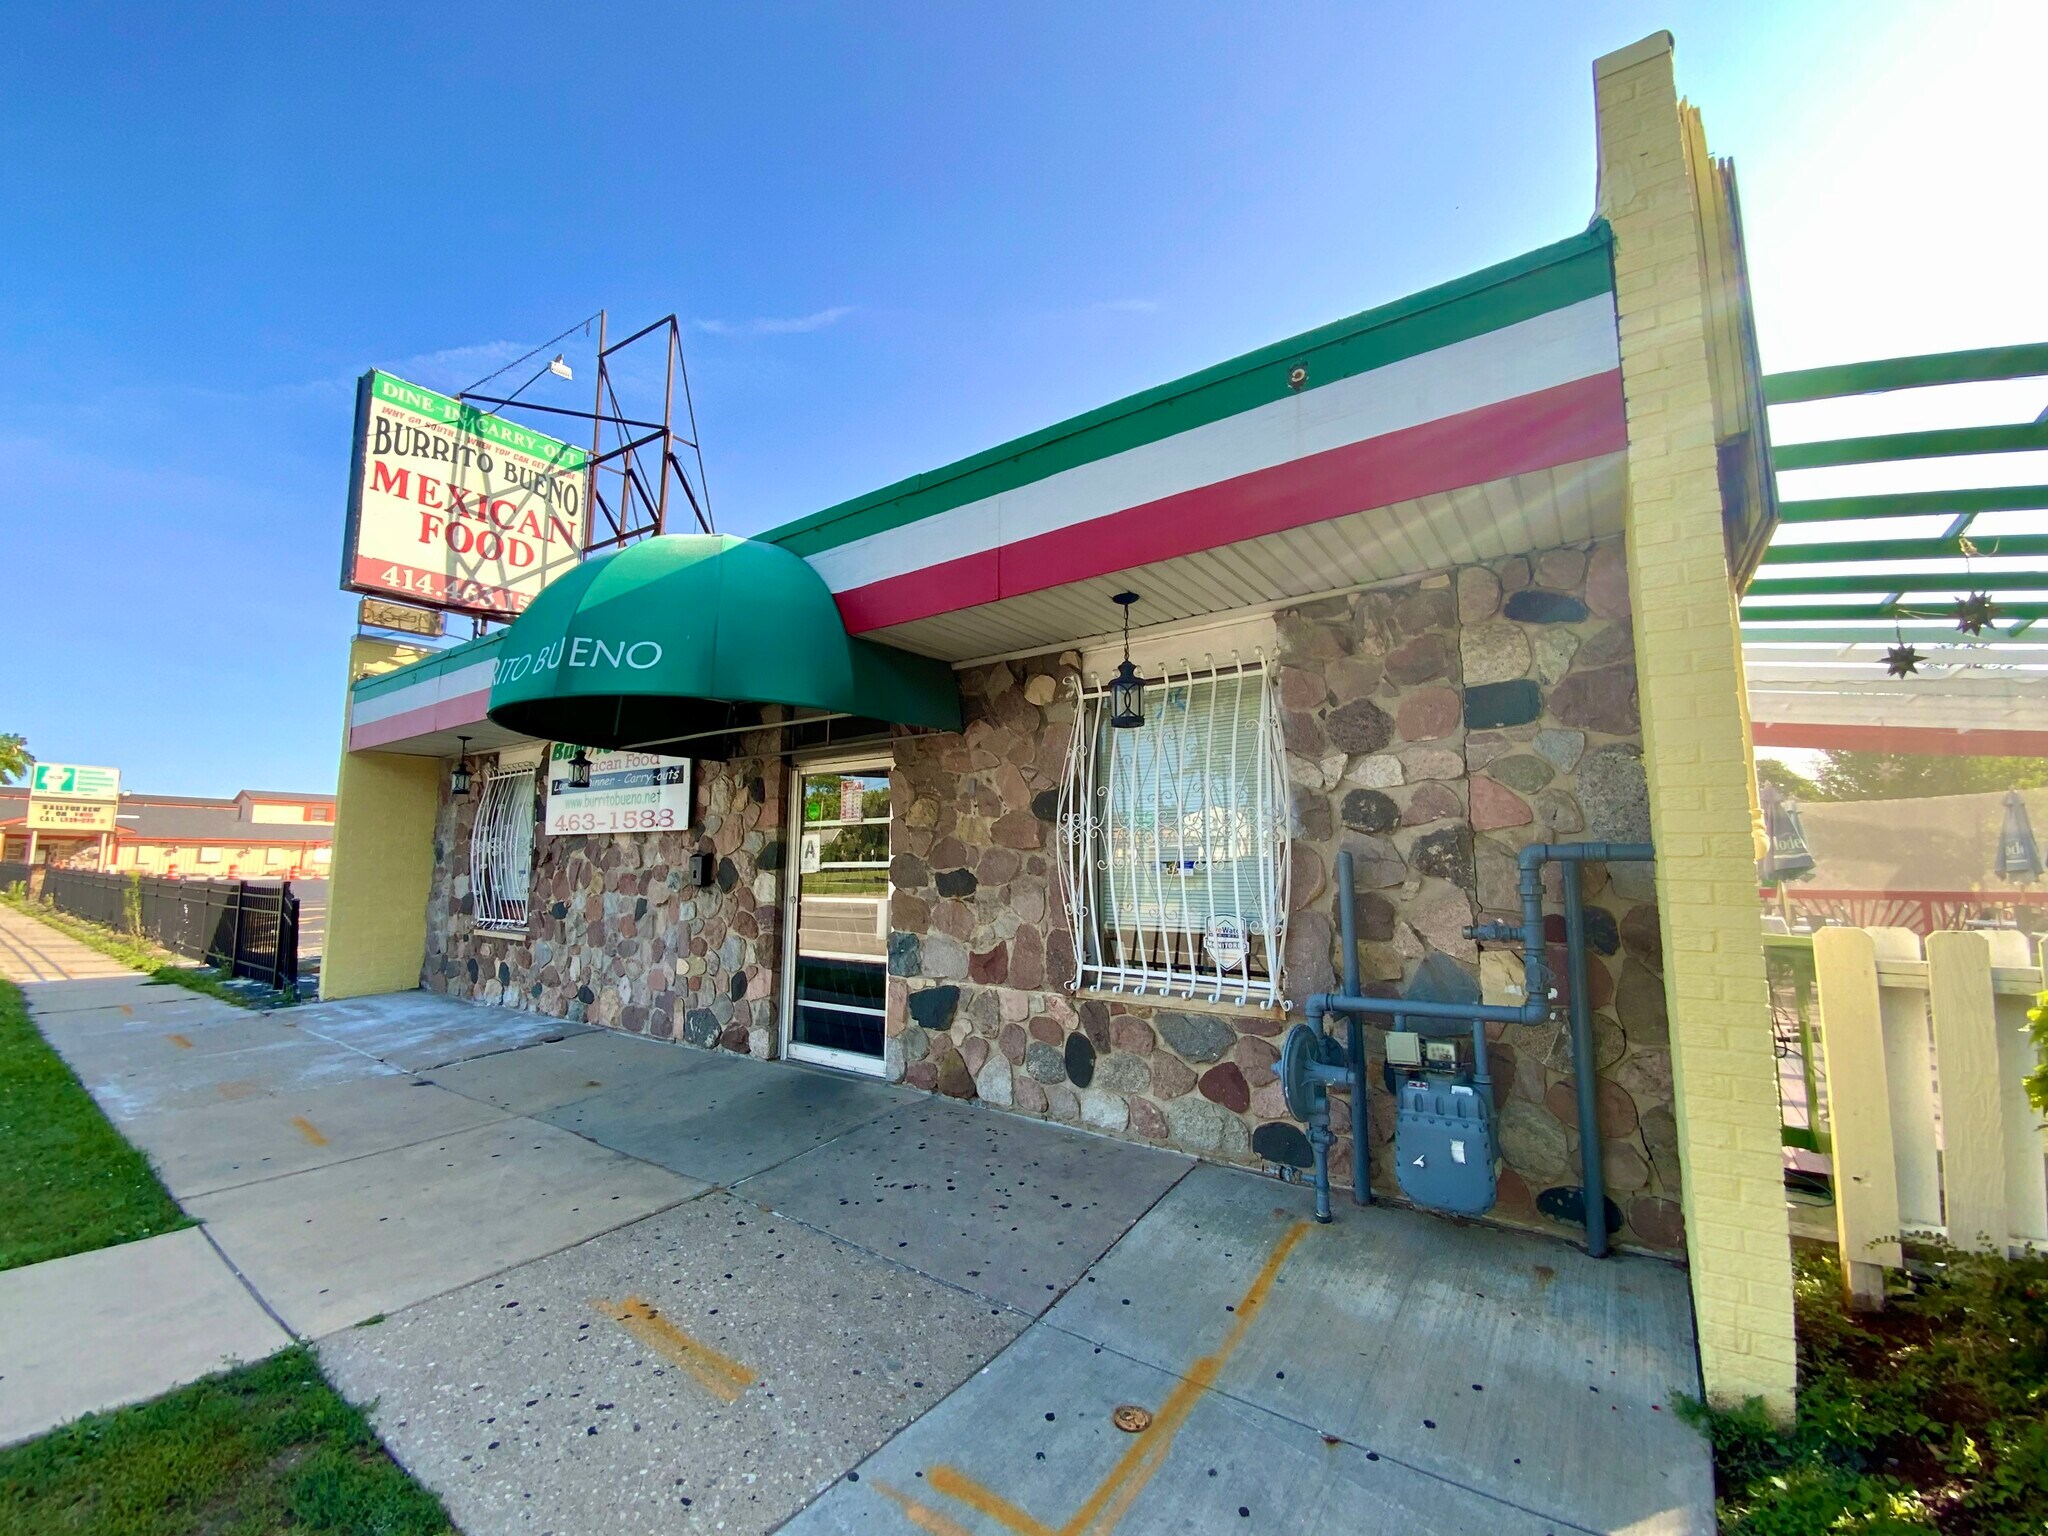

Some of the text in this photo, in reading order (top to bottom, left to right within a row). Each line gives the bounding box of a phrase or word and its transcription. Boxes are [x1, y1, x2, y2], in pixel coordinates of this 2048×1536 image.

[382, 406, 406, 420] WHY
[408, 416, 422, 425] GO
[425, 421, 455, 438] SOUTH
[467, 436, 492, 450] WHEN
[513, 453, 530, 464] CAN
[532, 460, 546, 470] GET
[373, 415, 578, 516] BURRITO BUENO
[369, 460, 577, 552] MEXICAN
[418, 511, 534, 568] FOOD
[532, 636, 663, 675] BUENO
[625, 753, 661, 769] Food
[624, 769, 680, 785] Carry-outs
[565, 790, 662, 809] www.burritobueno.net
[555, 809, 675, 831] 463-1588
[805, 840, 815, 859] A
[1206, 940, 1247, 950] MNITORD
